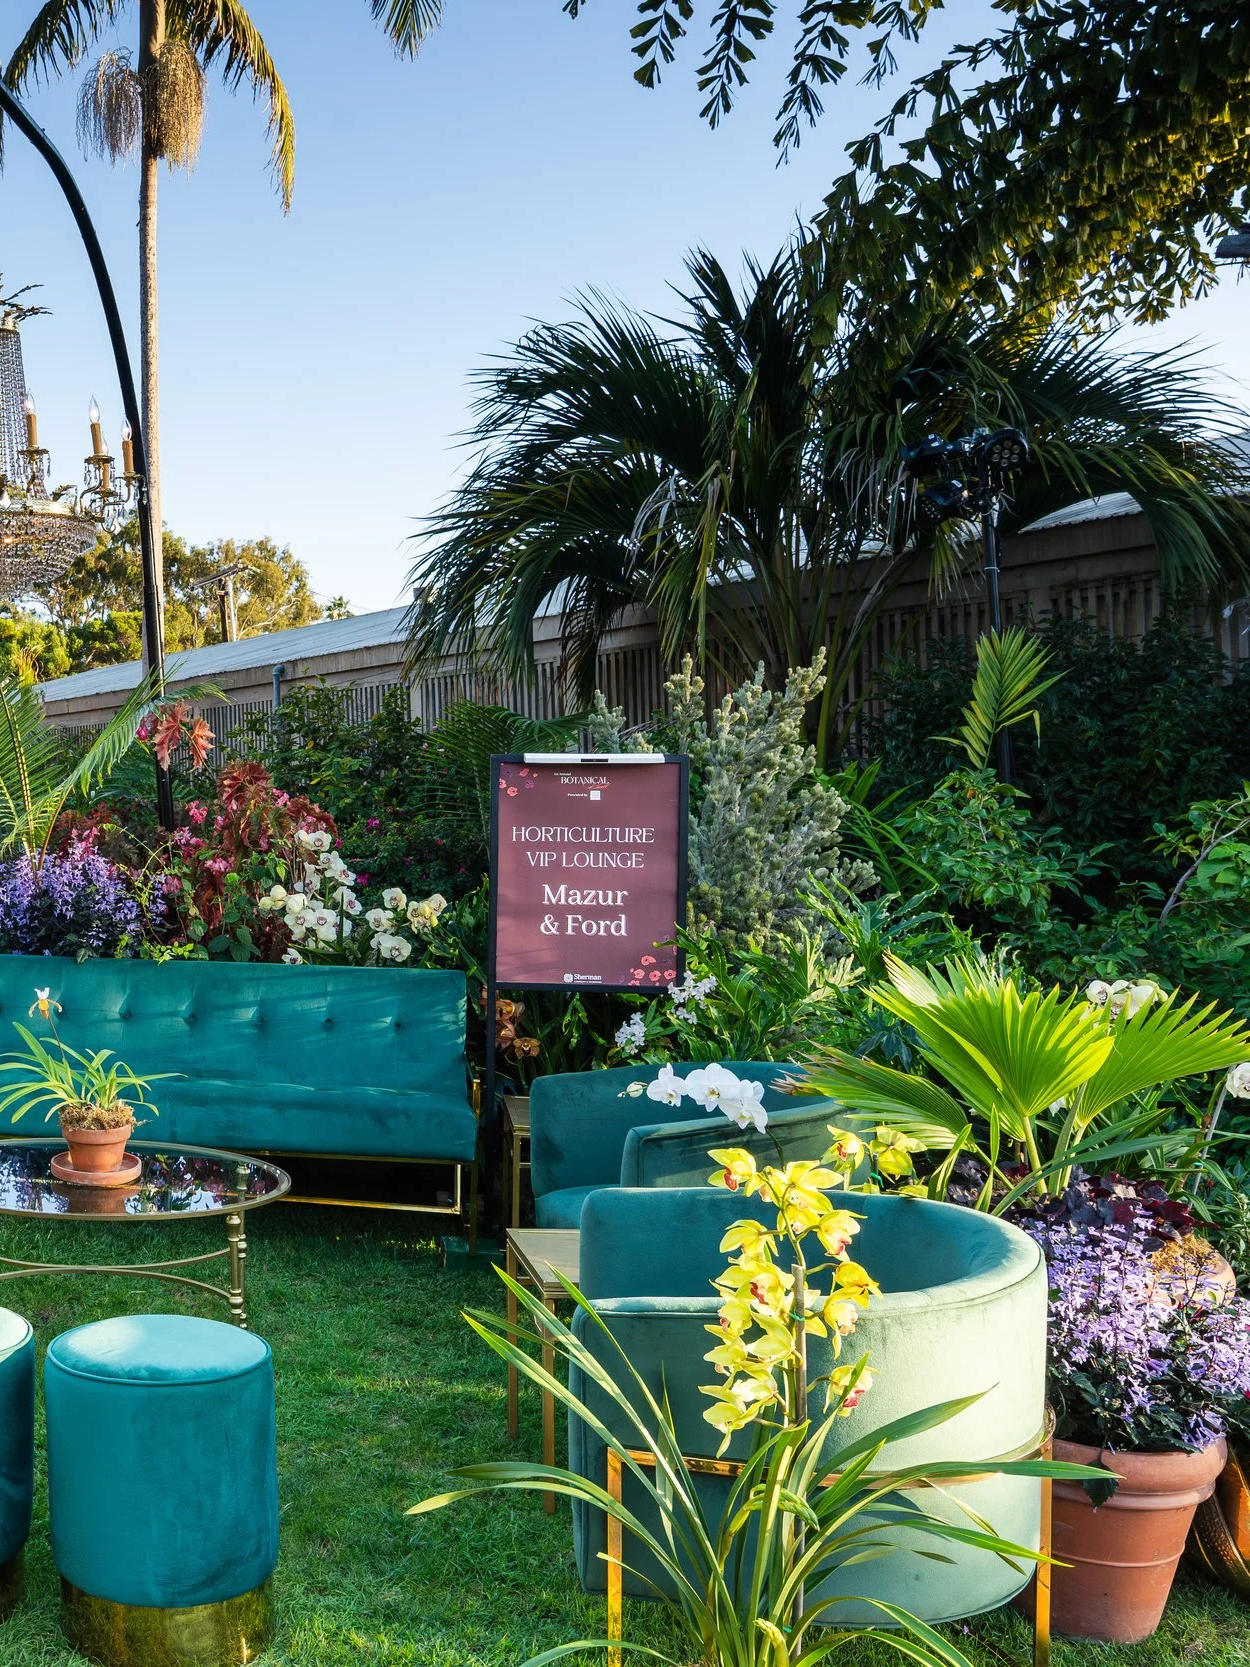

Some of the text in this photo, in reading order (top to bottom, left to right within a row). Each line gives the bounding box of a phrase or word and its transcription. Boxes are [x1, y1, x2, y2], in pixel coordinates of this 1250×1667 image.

[561, 776, 609, 785] BOTANICAL
[511, 826, 655, 844] HORTICULTURE
[526, 851, 645, 869] VIP LOUNGE
[541, 884, 629, 906] Mazur
[540, 914, 628, 937] & Ford
[574, 973, 602, 981] Sherman
